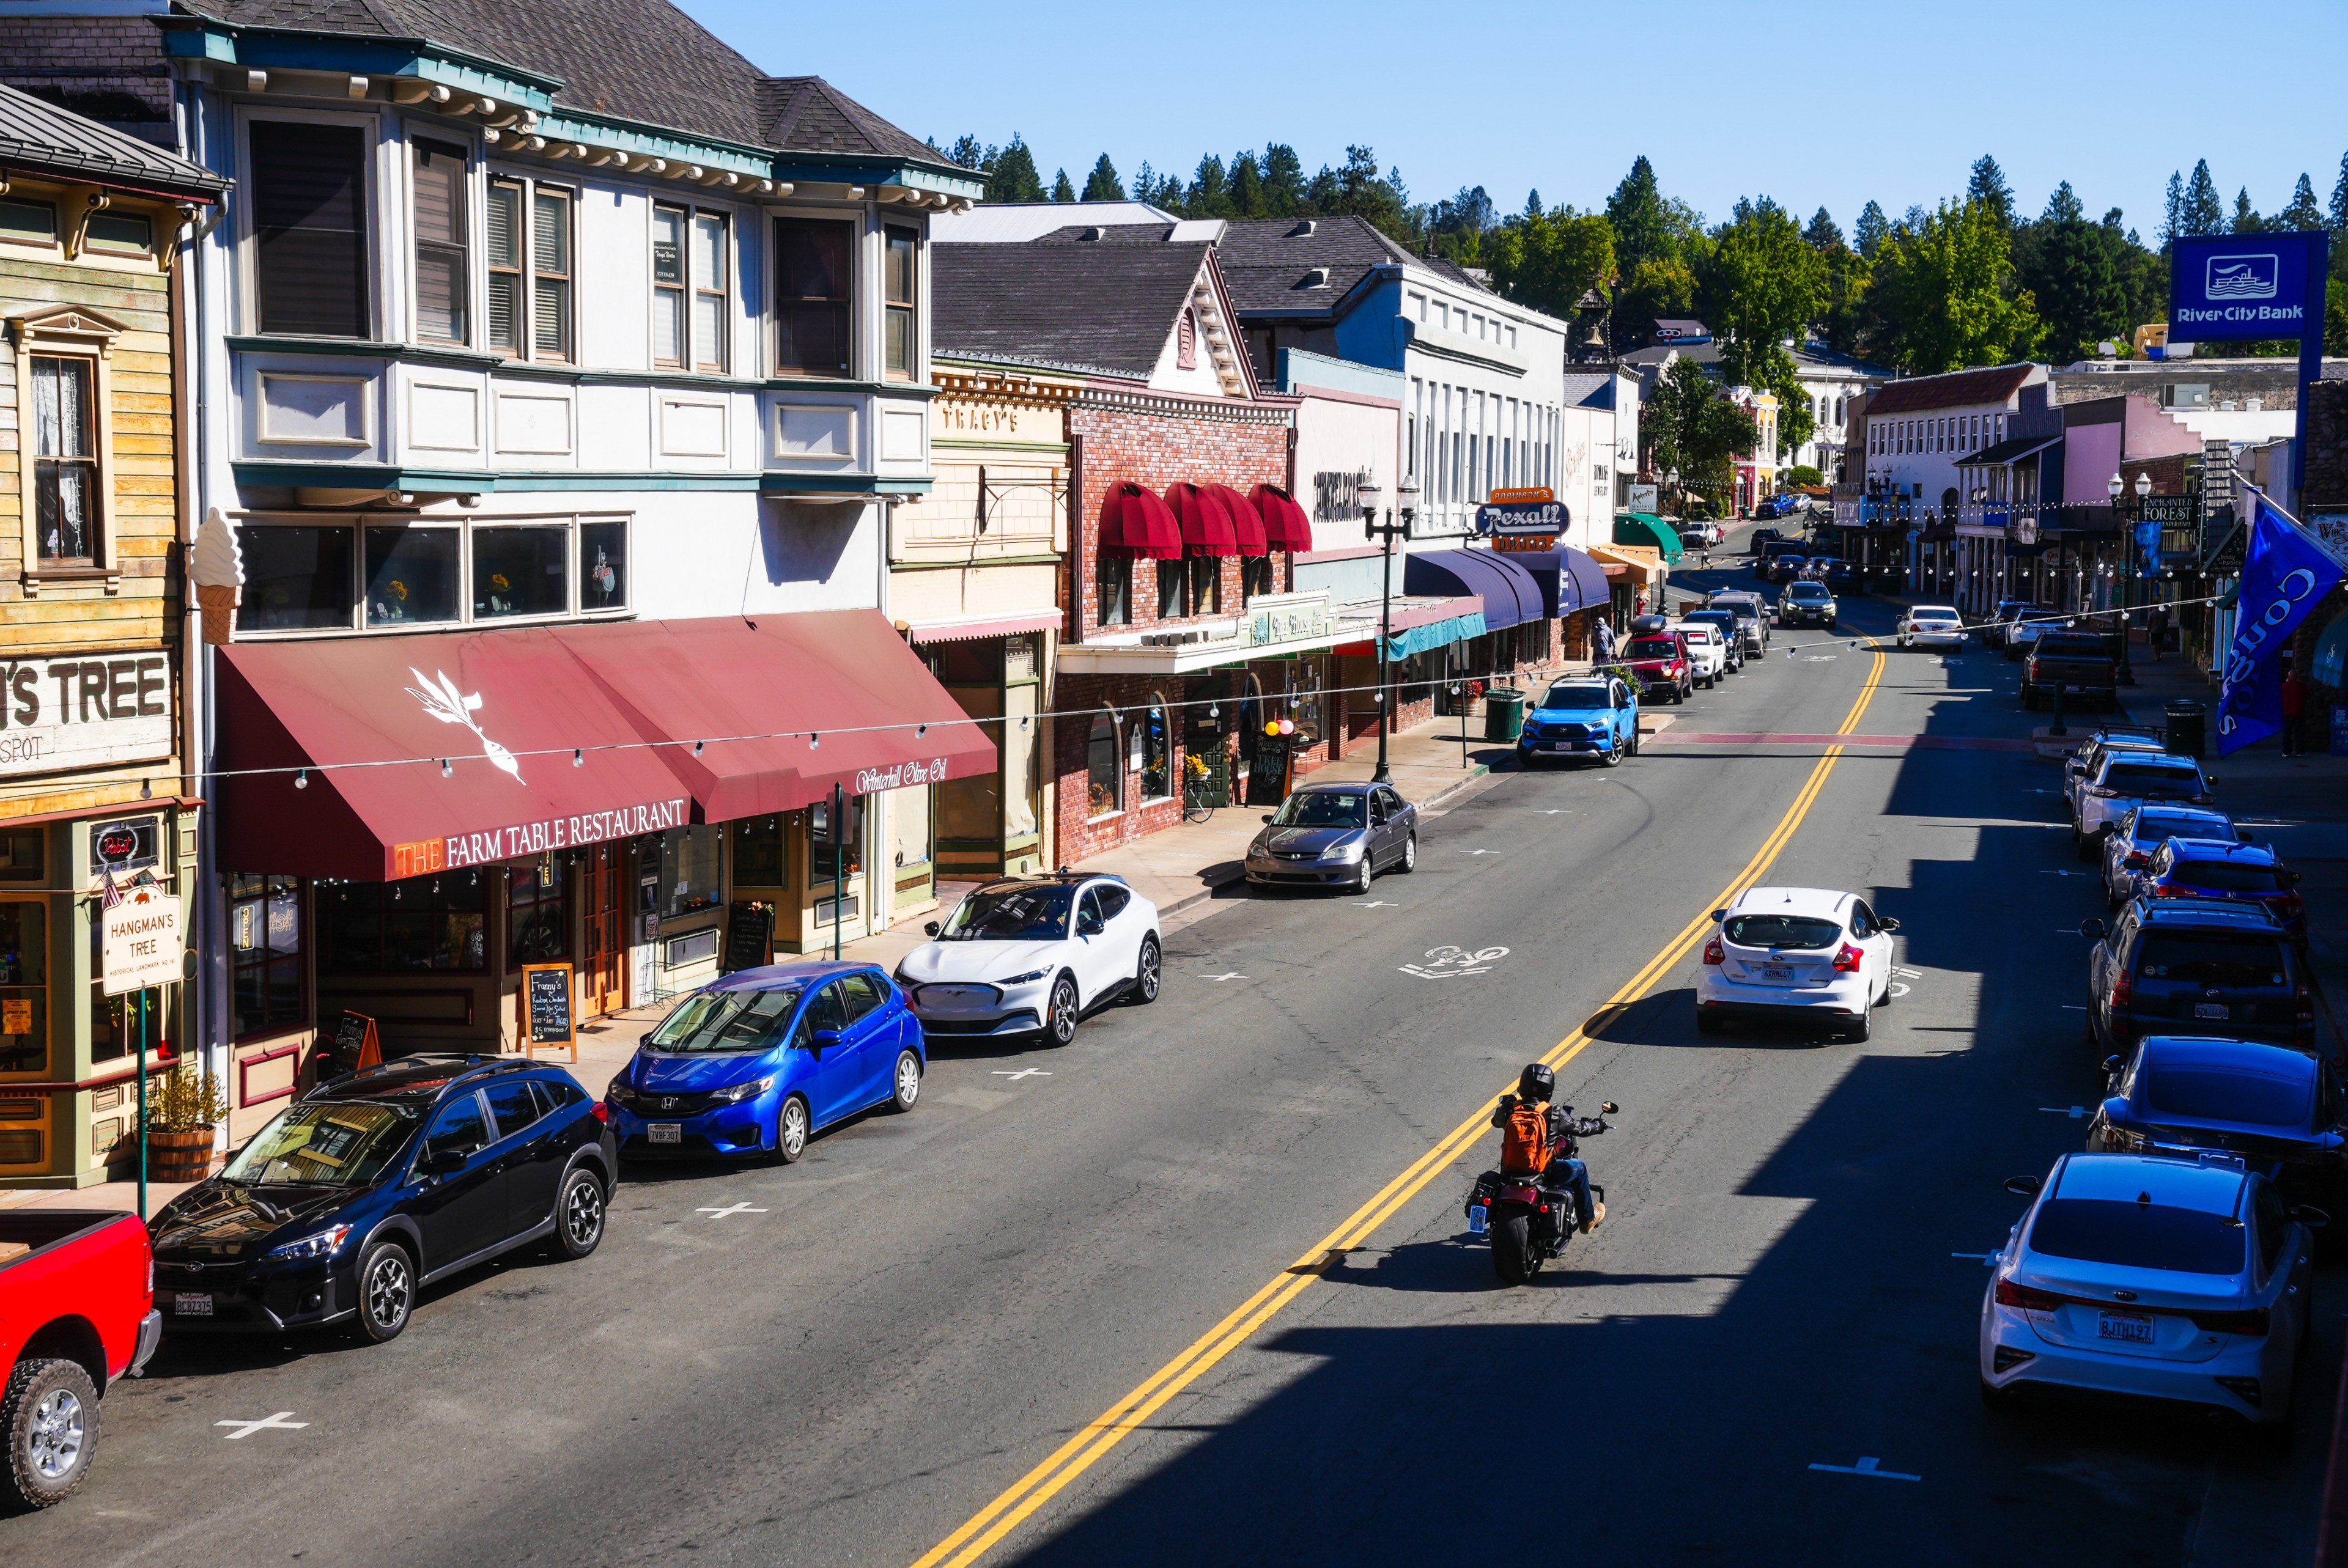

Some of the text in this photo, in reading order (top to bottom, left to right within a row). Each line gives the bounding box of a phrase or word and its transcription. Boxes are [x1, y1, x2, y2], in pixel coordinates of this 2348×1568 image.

[2177, 305, 2303, 322] River City Bank
[2144, 498, 2193, 507] ENCHANTED
[1485, 504, 1560, 534] Rexall
[2143, 507, 2192, 520] FOREST
[1499, 538, 1547, 550] DRUGS
[47, 657, 164, 724] TREE
[0, 736, 43, 763] SPOT
[856, 758, 947, 793] Winterhill Olive Oil
[1253, 764, 1284, 775] HOUSE
[396, 799, 685, 876] THE FARM TABLE RESTAURANT
[111, 913, 174, 939] HANGMAN'S
[130, 939, 157, 958] TREE
[109, 966, 135, 977] HISTORICAL
[136, 961, 160, 973] LANDMARK
[1764, 970, 1791, 978] 6XRM447
[531, 973, 562, 993] Franny's
[534, 1026, 543, 1035] $5
[651, 1131, 678, 1140] 7VBF307
[177, 1301, 212, 1312] 8CBZ375
[2102, 1321, 2150, 1339] 8JTH197
